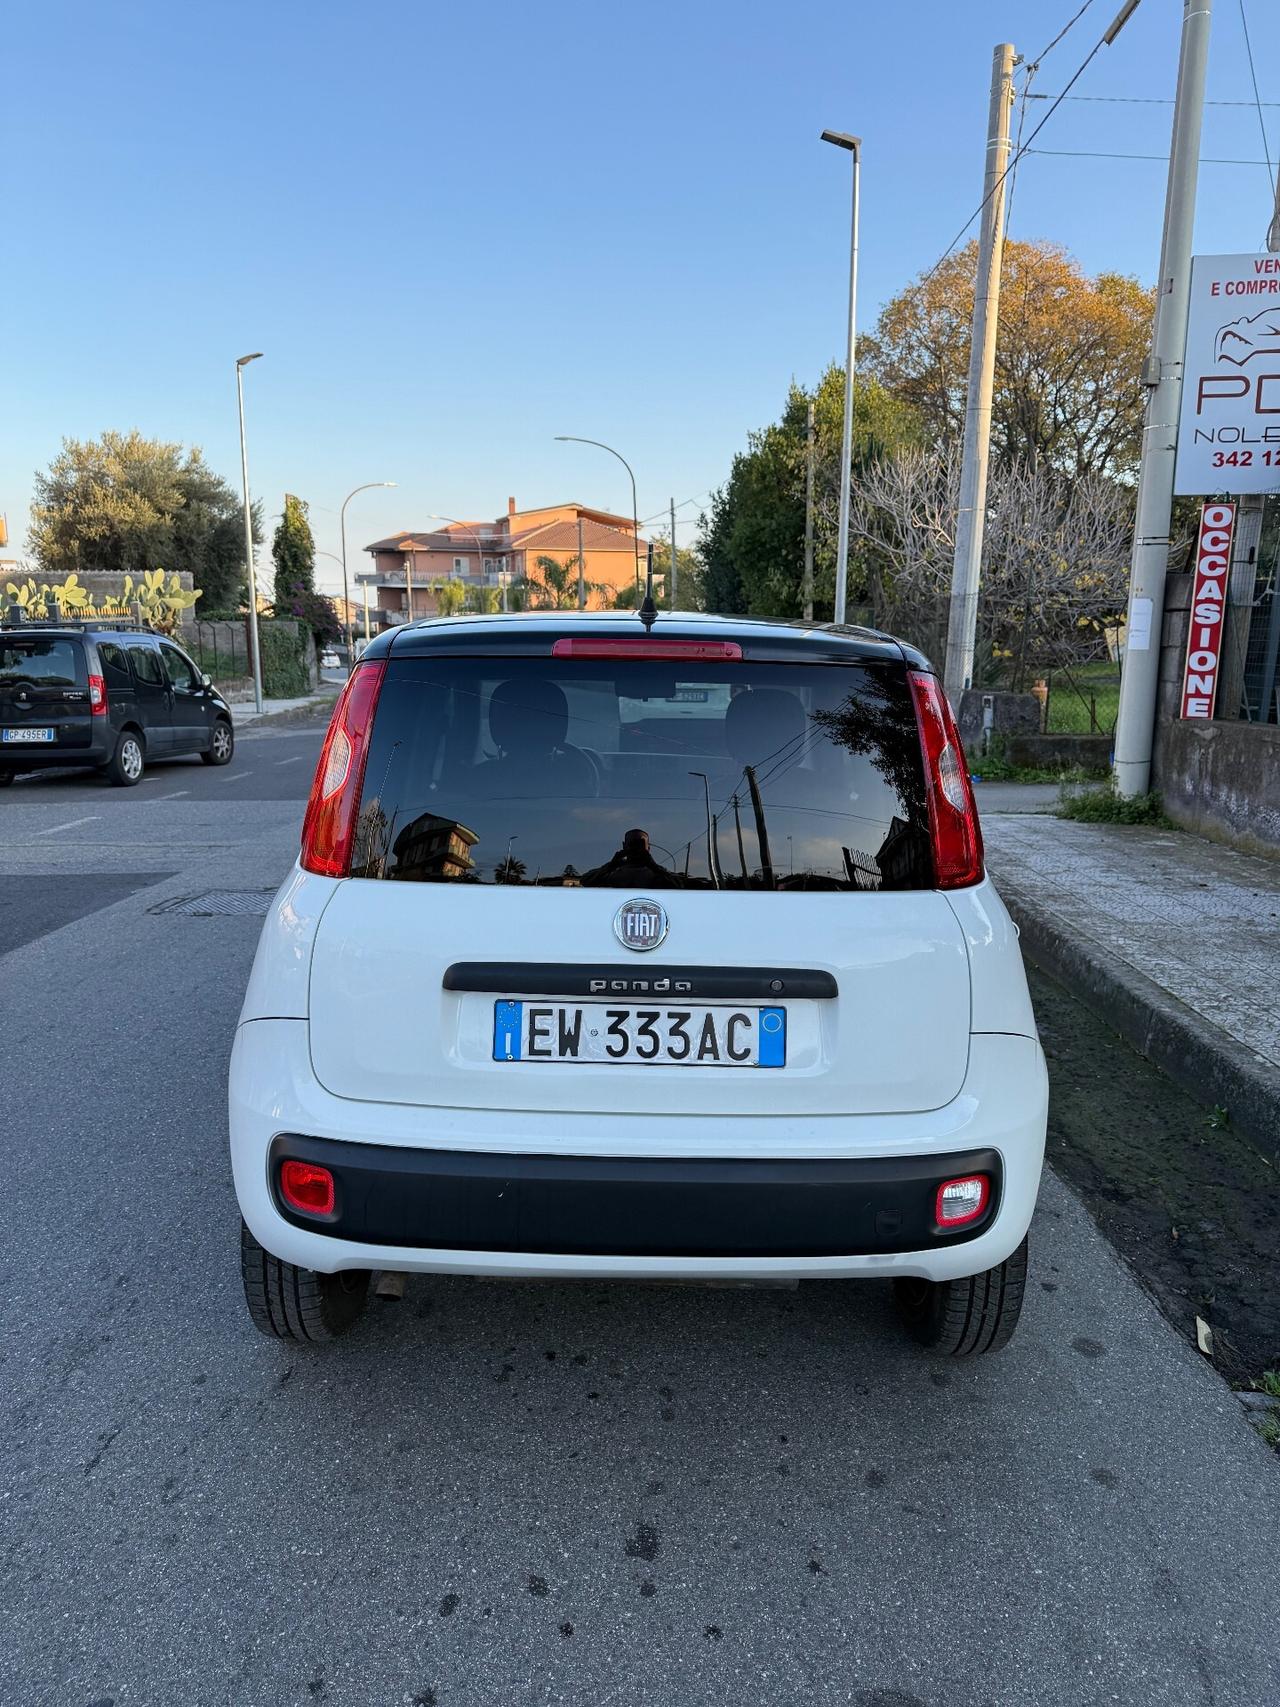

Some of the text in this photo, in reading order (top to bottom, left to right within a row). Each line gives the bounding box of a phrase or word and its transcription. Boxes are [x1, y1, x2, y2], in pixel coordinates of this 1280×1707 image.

[1211, 280, 1280, 296] E COMPR
[1212, 450, 1253, 467] 342
[1186, 506, 1233, 717] OCCASIONE
[626, 912, 658, 937] FIAT
[528, 1008, 752, 1062] EW 333AC
